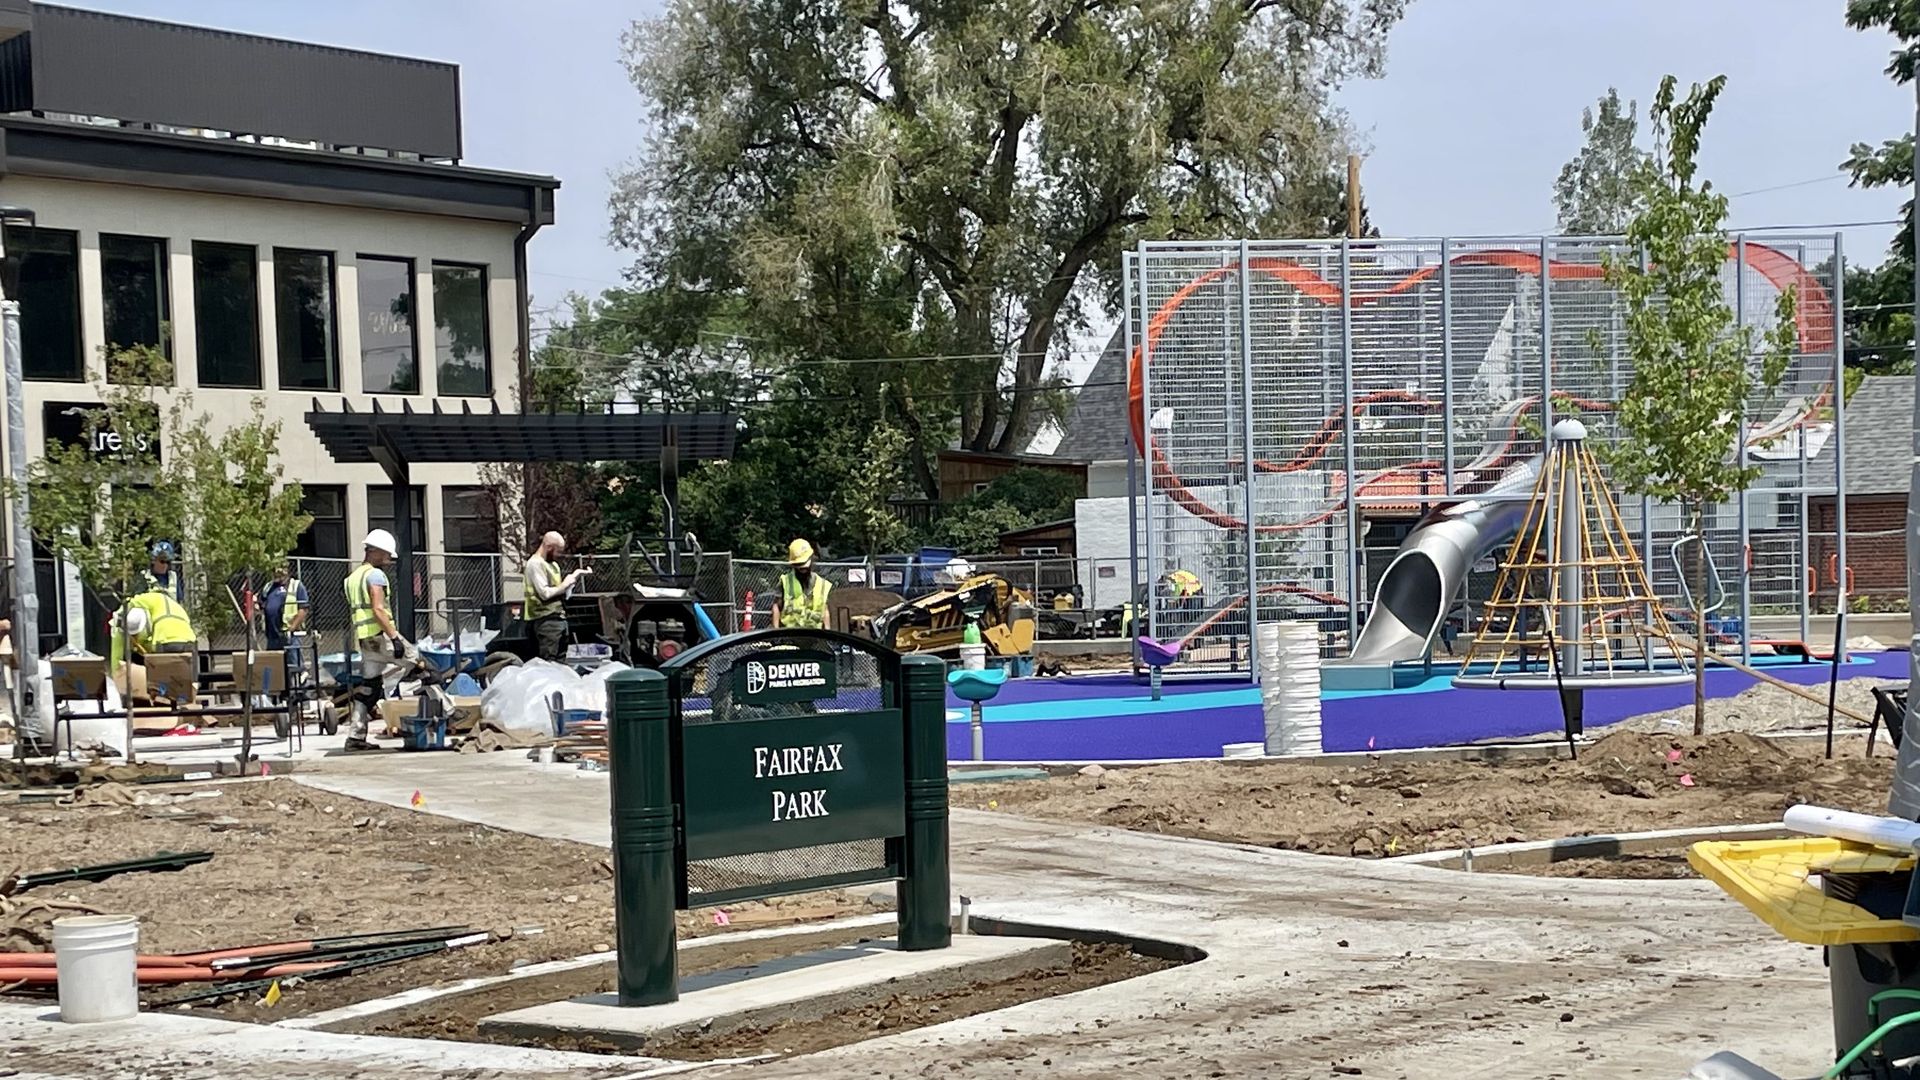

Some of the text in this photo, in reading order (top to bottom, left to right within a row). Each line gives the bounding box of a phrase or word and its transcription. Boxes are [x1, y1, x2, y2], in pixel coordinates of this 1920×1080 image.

[768, 662, 820, 679] DENVER
[754, 744, 843, 778] FAIRFAX
[772, 789, 829, 821] PARK
